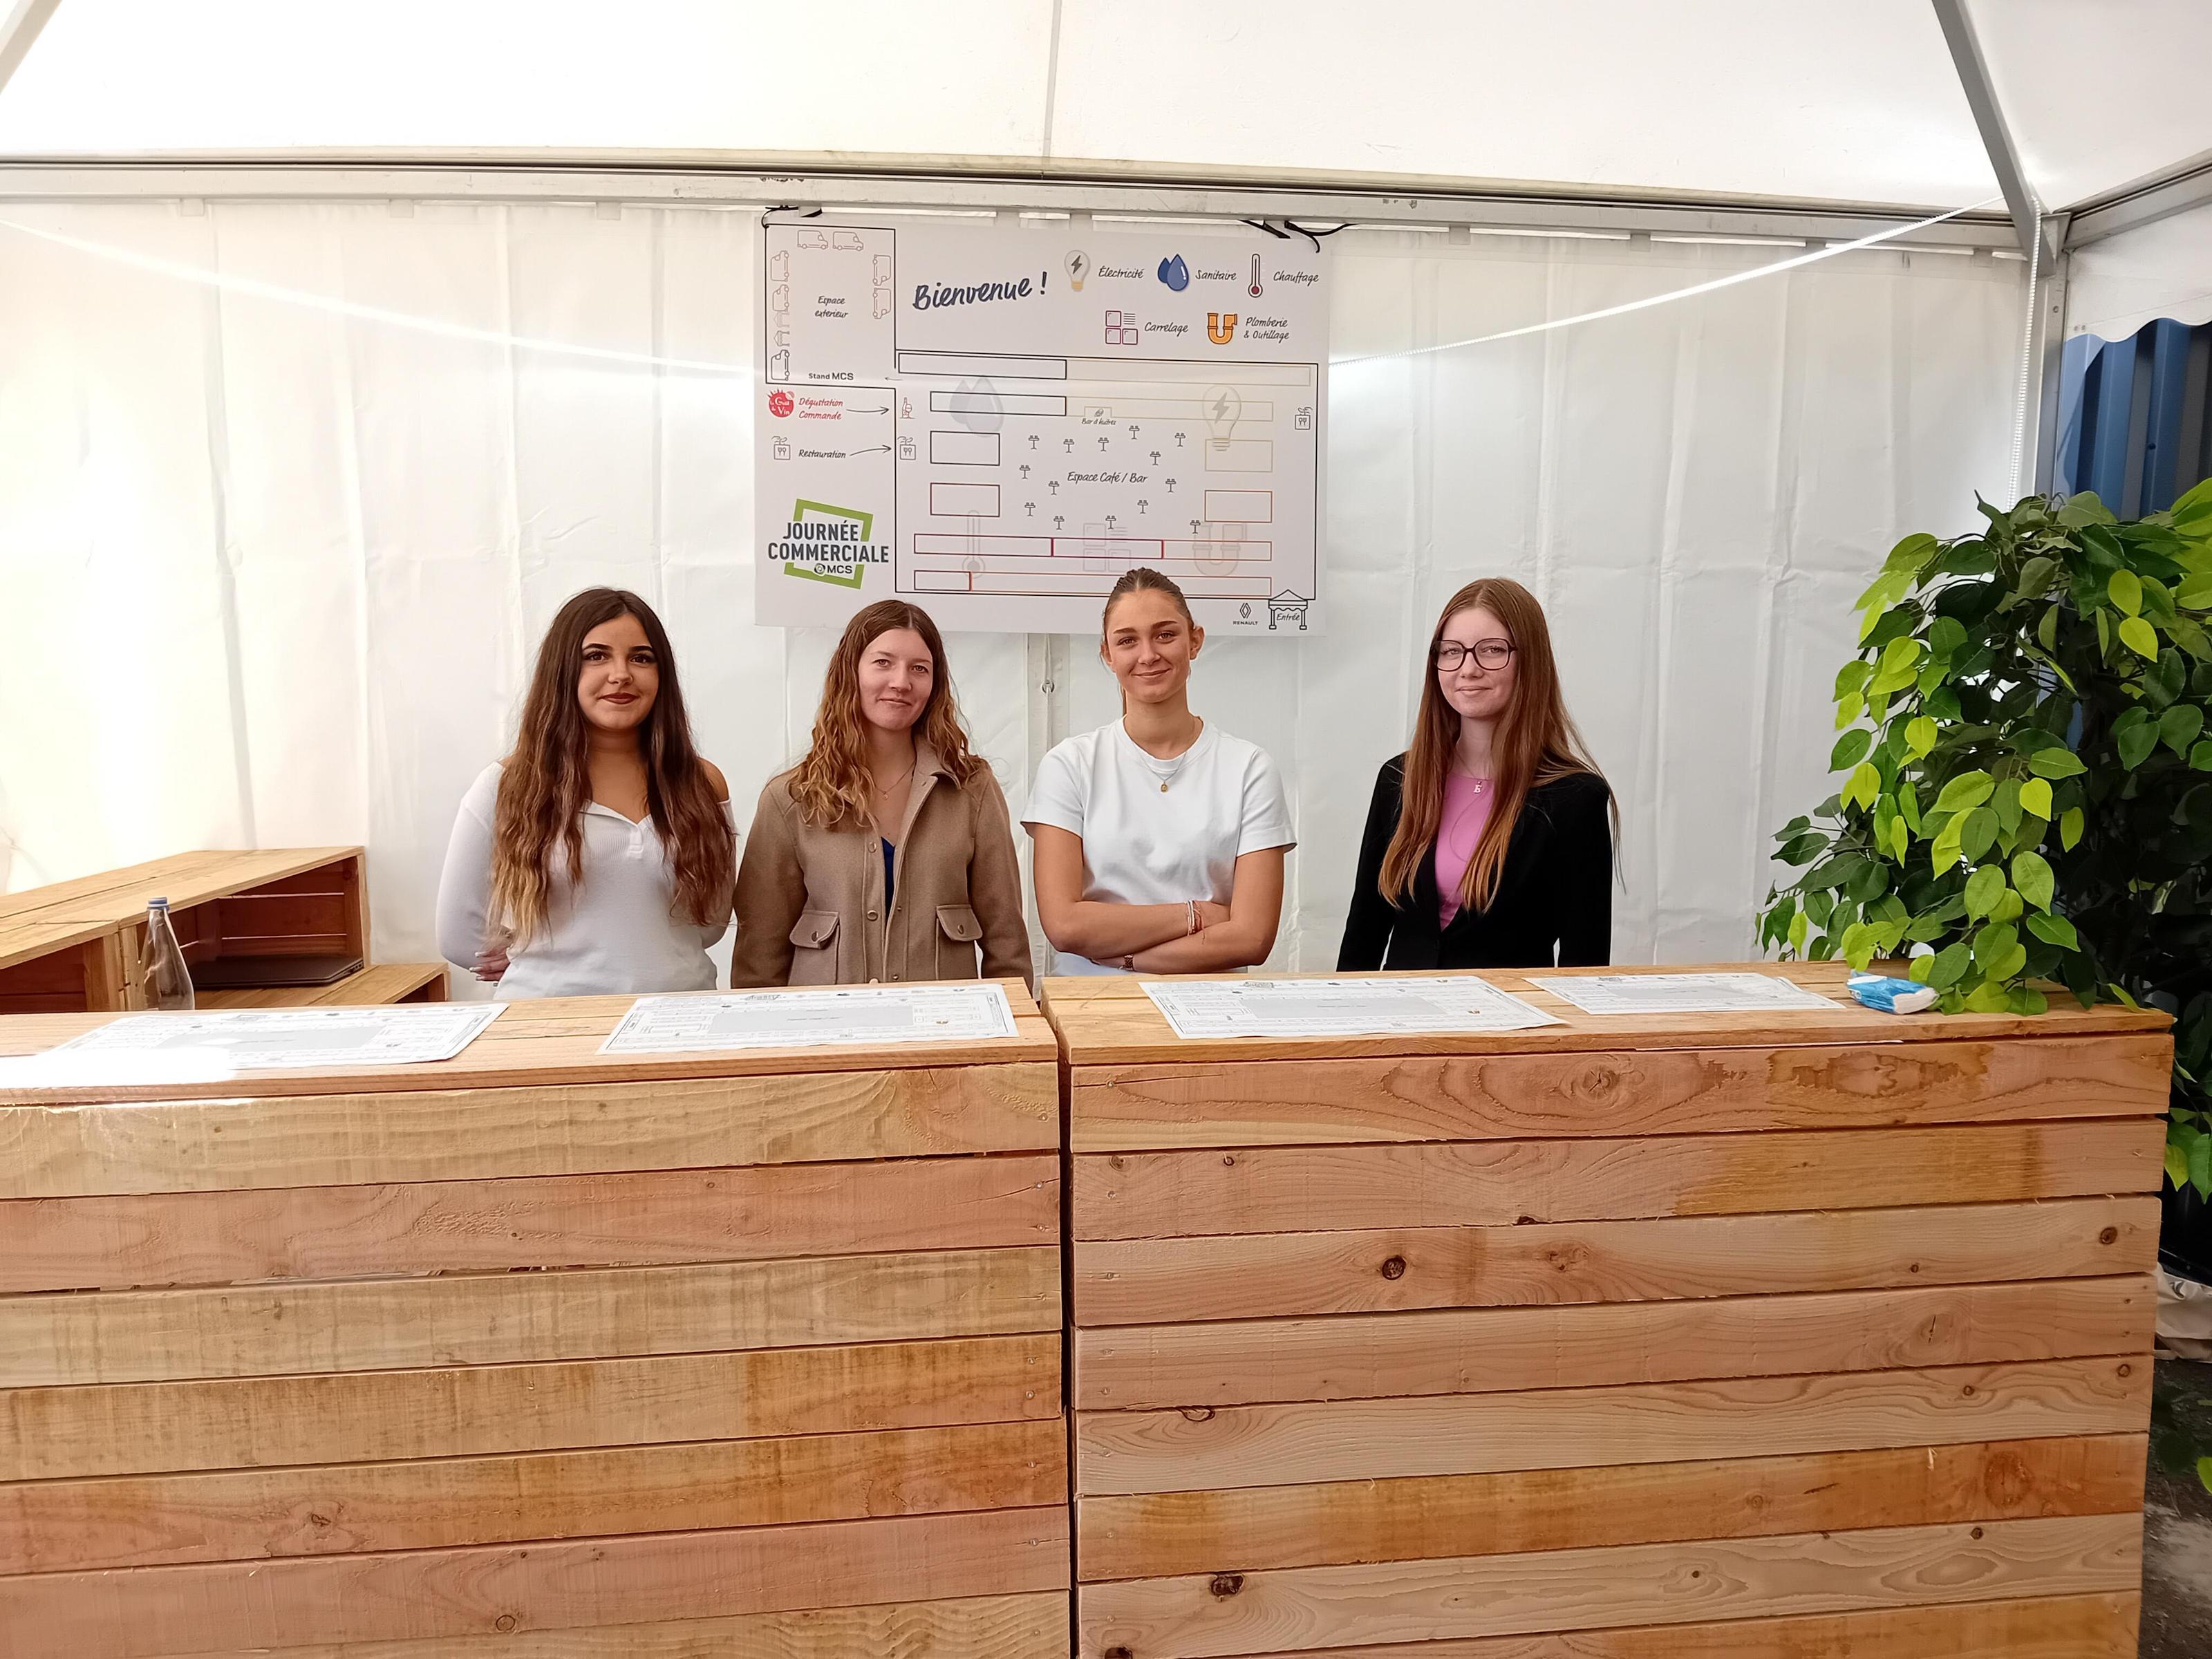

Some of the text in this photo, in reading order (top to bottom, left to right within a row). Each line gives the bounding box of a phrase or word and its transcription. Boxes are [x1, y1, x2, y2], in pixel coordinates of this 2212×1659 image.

[1098, 265, 1145, 279] Électricité
[1195, 269, 1237, 281] Sanitaire
[1273, 271, 1319, 286] Chauffage
[912, 272, 1047, 310] Bienvenue !
[818, 295, 845, 307] Espace
[1145, 321, 1188, 337] Carrelage
[1246, 317, 1288, 328] Plomberie
[1253, 330, 1289, 344] Outillage
[808, 371, 854, 381] Stand MCS
[798, 397, 843, 409] Dégustation
[798, 411, 841, 420] Commande
[798, 449, 846, 459] Restauration
[1067, 472, 1098, 485] Espace
[1100, 471, 1121, 485] Café
[1130, 473, 1149, 483] Bar
[782, 520, 859, 542] JOURNÉE
[768, 542, 889, 563] COMMERCIALE
[827, 565, 852, 574] MCS
